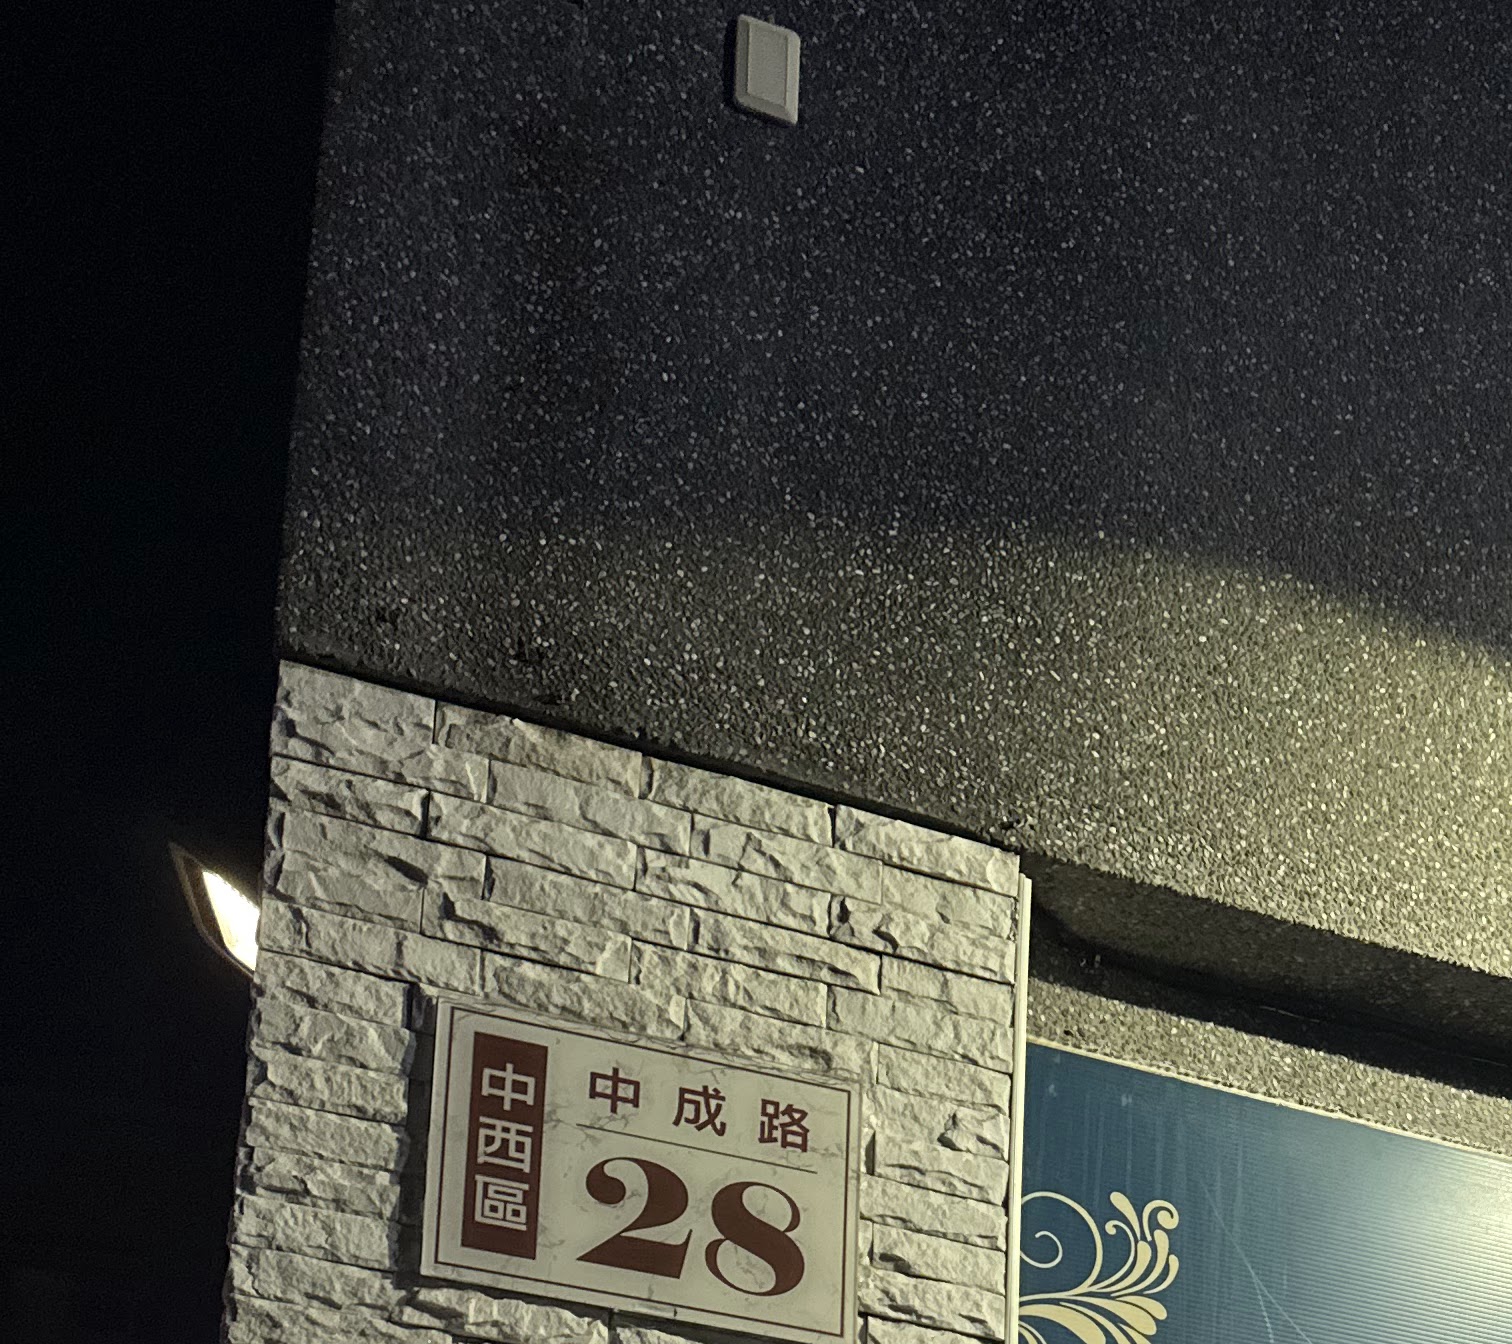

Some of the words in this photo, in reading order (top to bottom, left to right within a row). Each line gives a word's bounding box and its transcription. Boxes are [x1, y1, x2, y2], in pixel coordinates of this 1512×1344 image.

[473, 1062, 537, 1232] 中西區
[587, 1066, 811, 1153] 中成路
[576, 1156, 806, 1297] 28
